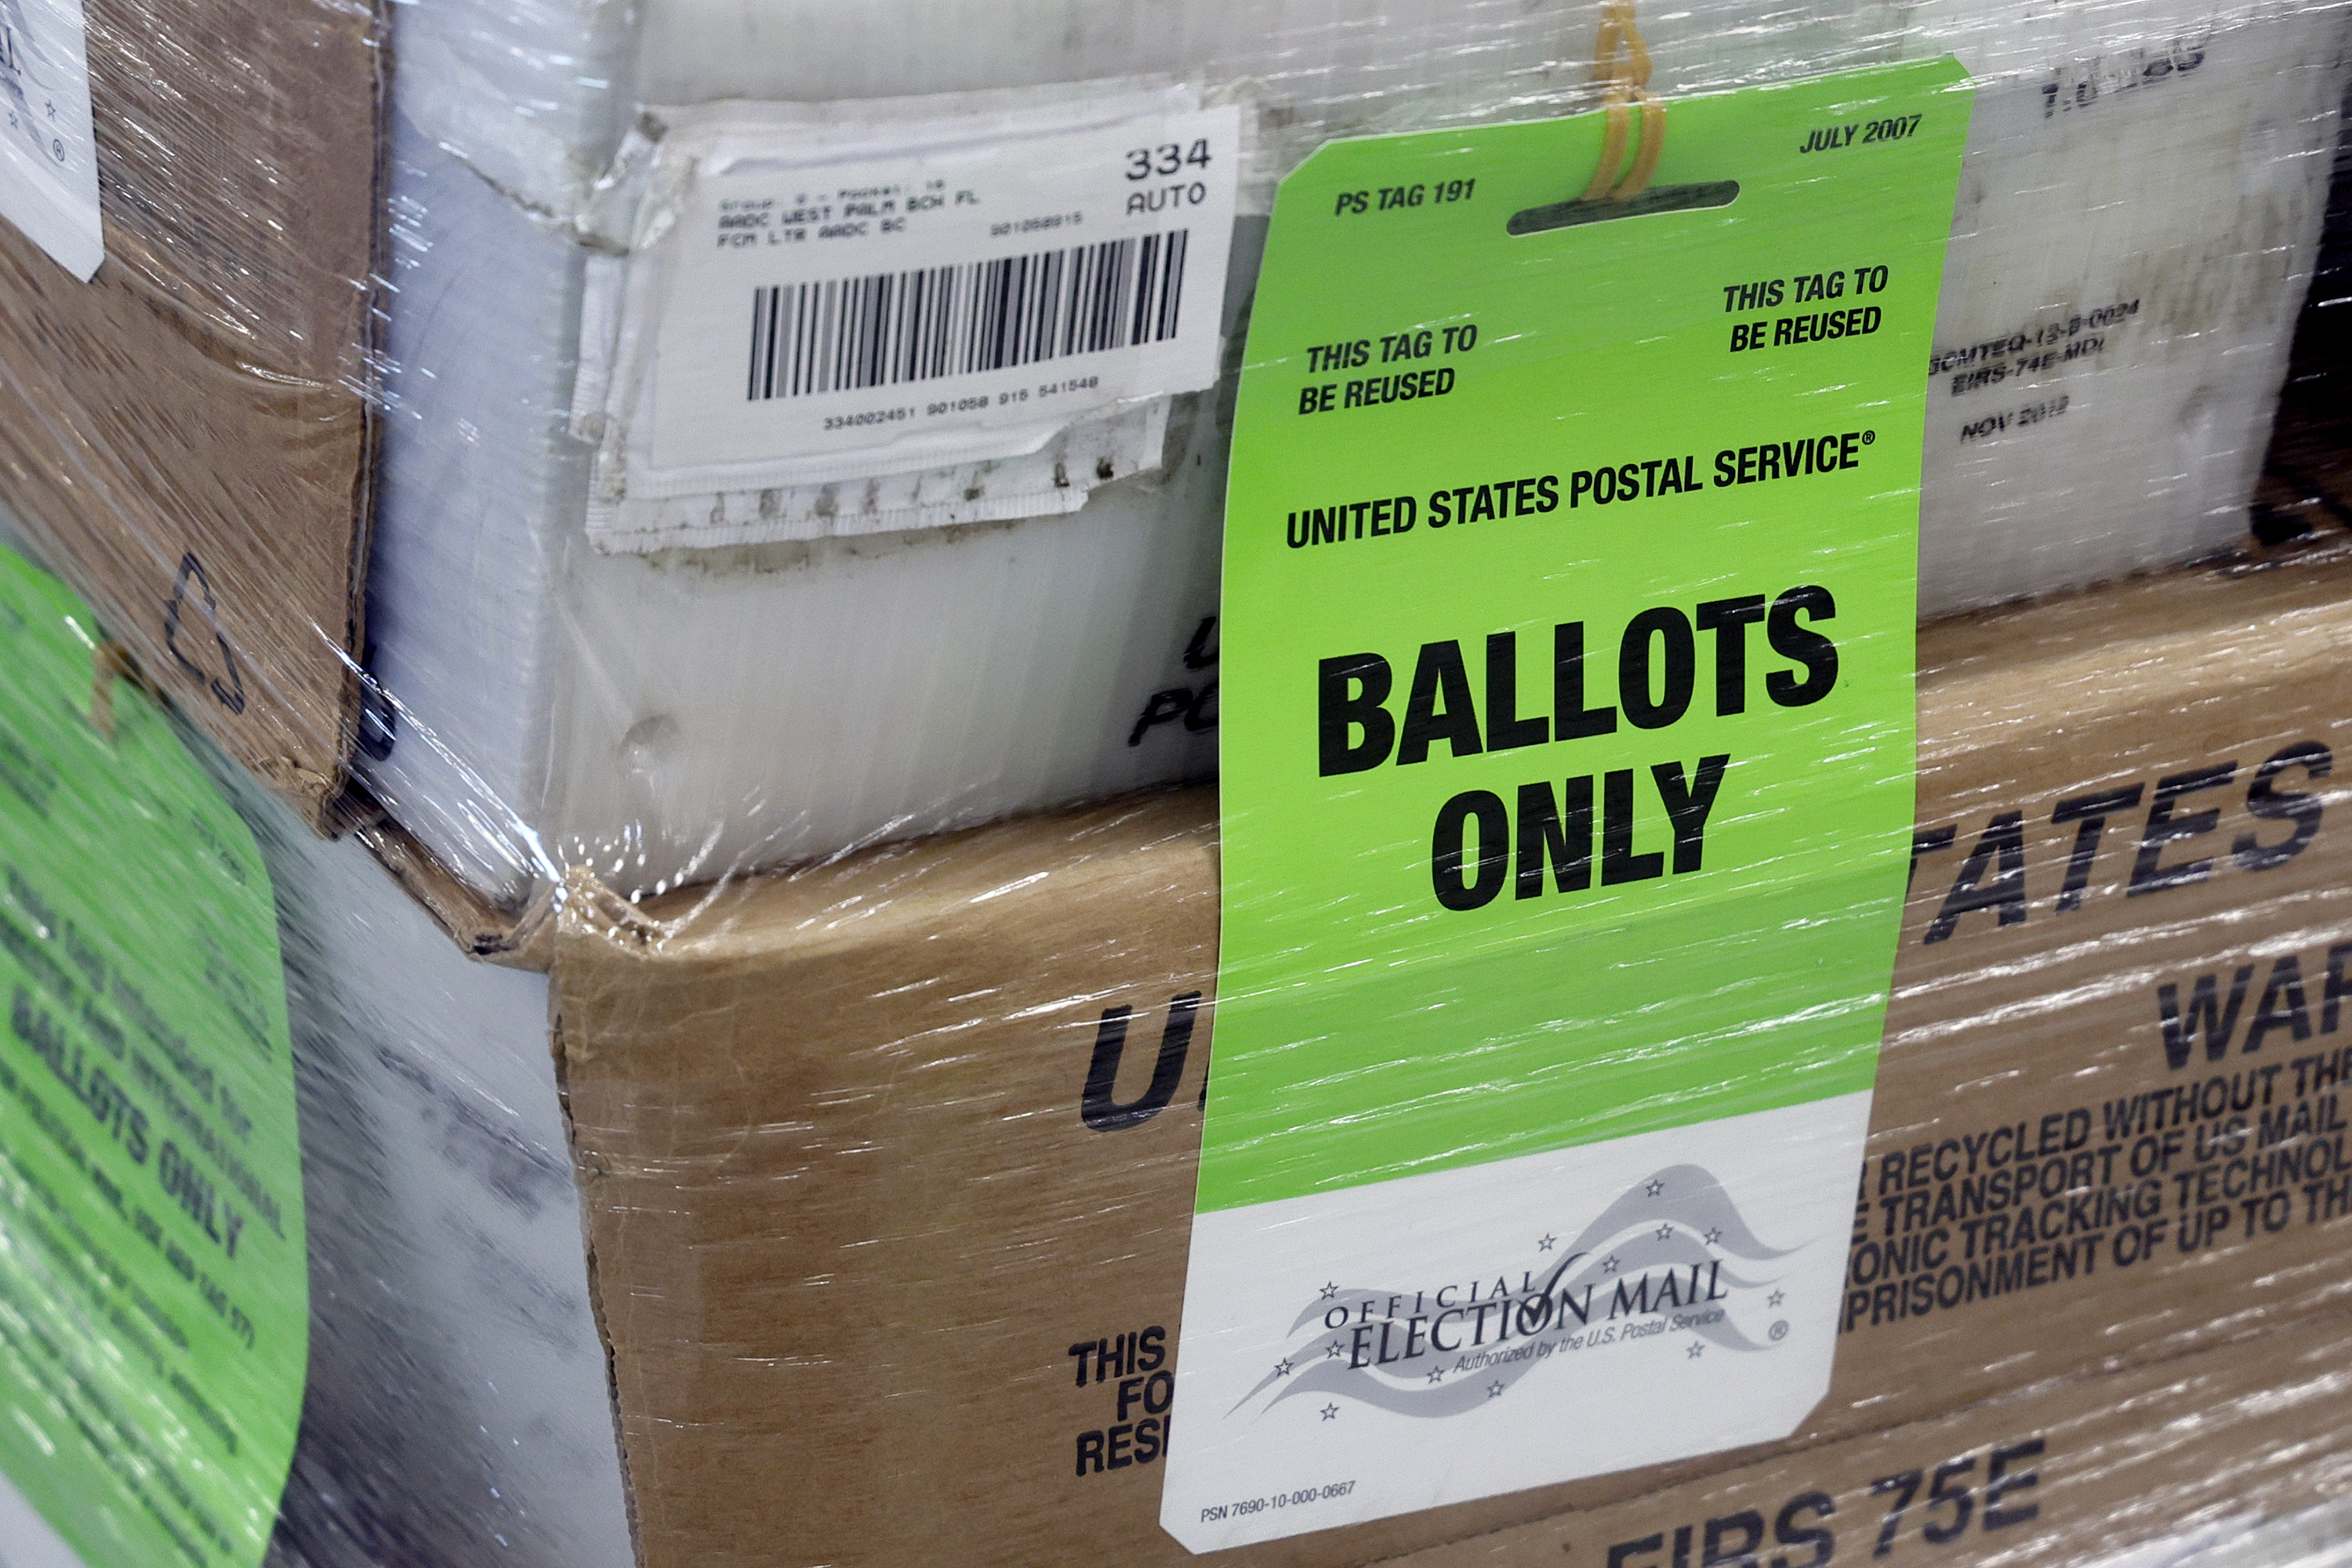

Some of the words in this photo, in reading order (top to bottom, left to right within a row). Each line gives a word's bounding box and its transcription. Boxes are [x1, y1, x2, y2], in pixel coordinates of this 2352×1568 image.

[1126, 138, 1211, 180] 334
[1799, 124, 1859, 154] JULY
[1861, 114, 1923, 144] 2007
[782, 205, 832, 224] WEST
[844, 200, 895, 217] PALM
[906, 195, 945, 212] BCH
[955, 190, 978, 205] FL
[1127, 182, 1206, 215] AUTO
[1335, 191, 1370, 216] PS
[1377, 183, 1425, 211] TAG
[1433, 177, 1475, 204] 191
[717, 233, 757, 248] FCM
[1723, 279, 1784, 313] THIS
[1793, 270, 1846, 303] TAG
[1853, 264, 1889, 296] TO
[1307, 339, 1371, 373] THIS
[1379, 330, 1433, 363] TAG
[1442, 324, 1478, 354] TO
[1730, 321, 1768, 353] BE
[1773, 306, 1882, 347] REUSED
[823, 406, 916, 430] 334002451
[926, 395, 989, 416] 901058
[998, 389, 1029, 406] 915
[1038, 376, 1099, 398] 541548
[1298, 383, 1338, 415] BE
[1344, 367, 1456, 408] REUSED
[1961, 411, 2013, 442] NOV
[1287, 495, 1417, 549] UNITED
[1428, 475, 1559, 528] STATES
[1570, 456, 1703, 509] POSTAL
[1319, 585, 1839, 778] BALLOTS
[1432, 753, 1731, 912] ONLY
[1081, 990, 1208, 1131] U
[1879, 1108, 2092, 1196] RECYCLED
[2103, 1064, 2282, 1141] WITHOUT
[1880, 1144, 2122, 1237] TRANSPORT
[2129, 1128, 2185, 1178] OF
[2194, 1116, 2248, 1163] US
[2257, 1094, 2347, 1149] MAIL
[159, 1138, 245, 1258] ONLY
[1846, 1228, 1951, 1286] ONIC
[1960, 1178, 2162, 1259] TRACKING
[1838, 1233, 2104, 1335] PRISONMENT
[2112, 1219, 2168, 1267] OF
[2178, 1205, 2230, 1252] UP
[2240, 1190, 2291, 1237] TO
[1324, 1271, 1536, 1330] OFFICIAL
[1347, 1283, 1596, 1370] ELECTION
[1607, 1258, 1729, 1320] MAIL
[1068, 1326, 1167, 1388] THIS
[1453, 1344, 1534, 1374] Authorized
[1537, 1341, 1558, 1359] by
[1559, 1334, 1584, 1351] the
[1588, 1328, 1617, 1347] U.S.
[1620, 1316, 1667, 1342] Postal
[1669, 1309, 1725, 1332] Service
[1076, 1417, 1171, 1477] RES
[1200, 1505, 1228, 1523] PSN
[1231, 1480, 1356, 1517] 7690-10-000-0667
[1871, 1438, 2045, 1559] 75E
